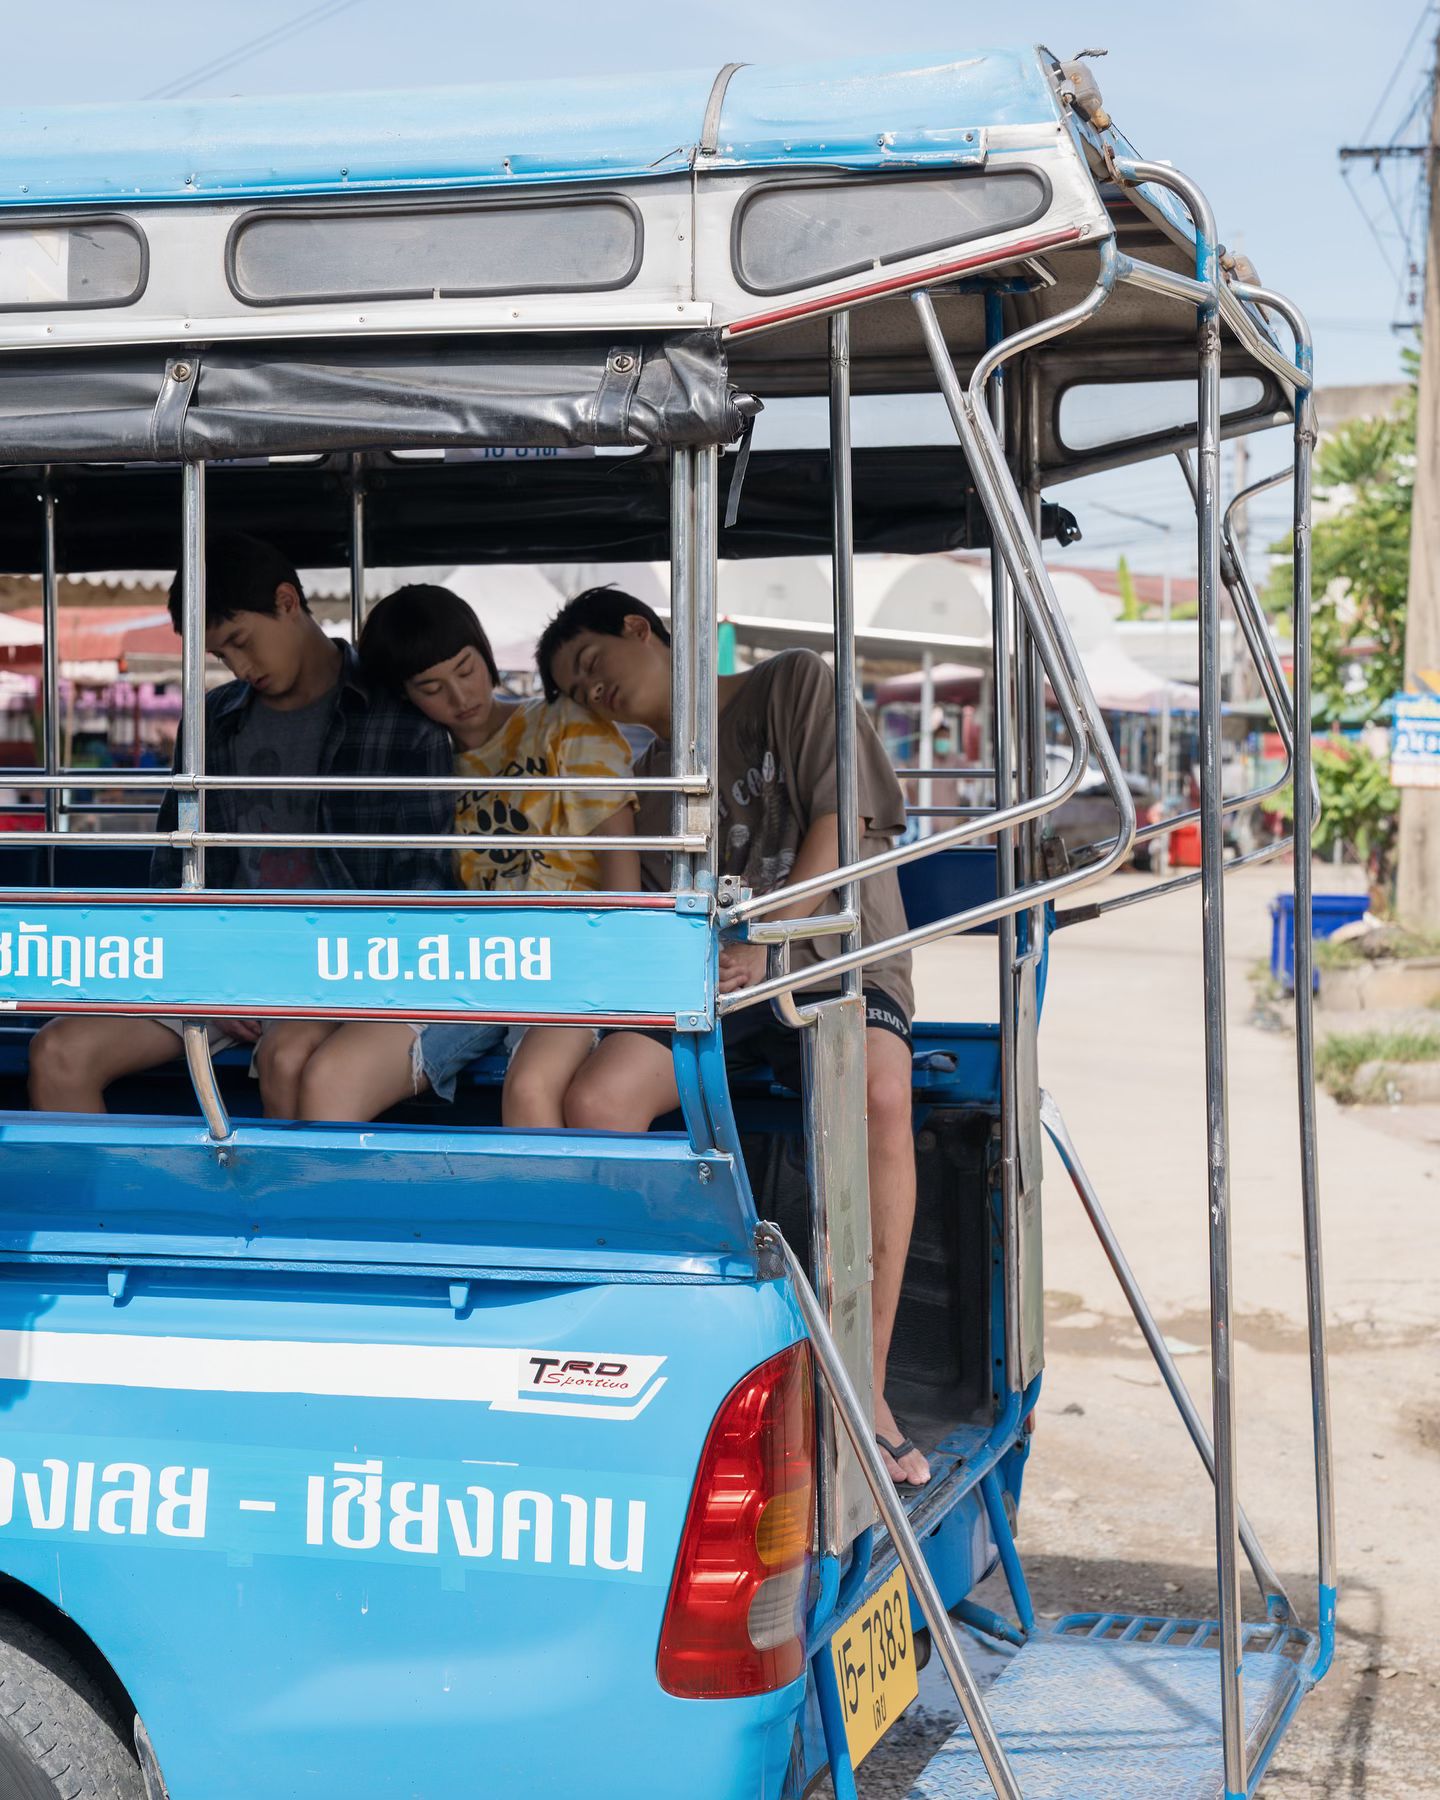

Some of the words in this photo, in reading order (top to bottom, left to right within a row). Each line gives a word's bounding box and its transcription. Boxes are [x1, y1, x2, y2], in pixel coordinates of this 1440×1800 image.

[0, 921, 164, 987] ภัฏเลย
[317, 934, 552, 981] บ.ข.ส.เลย
[866, 1007, 909, 1036] RMY
[529, 1357, 629, 1385] TRD
[543, 1373, 629, 1390] Sportivo
[306, 1460, 647, 1573] เชียงคาน
[838, 1589, 907, 1722] 15-7383
[872, 1692, 887, 1732] เลย
